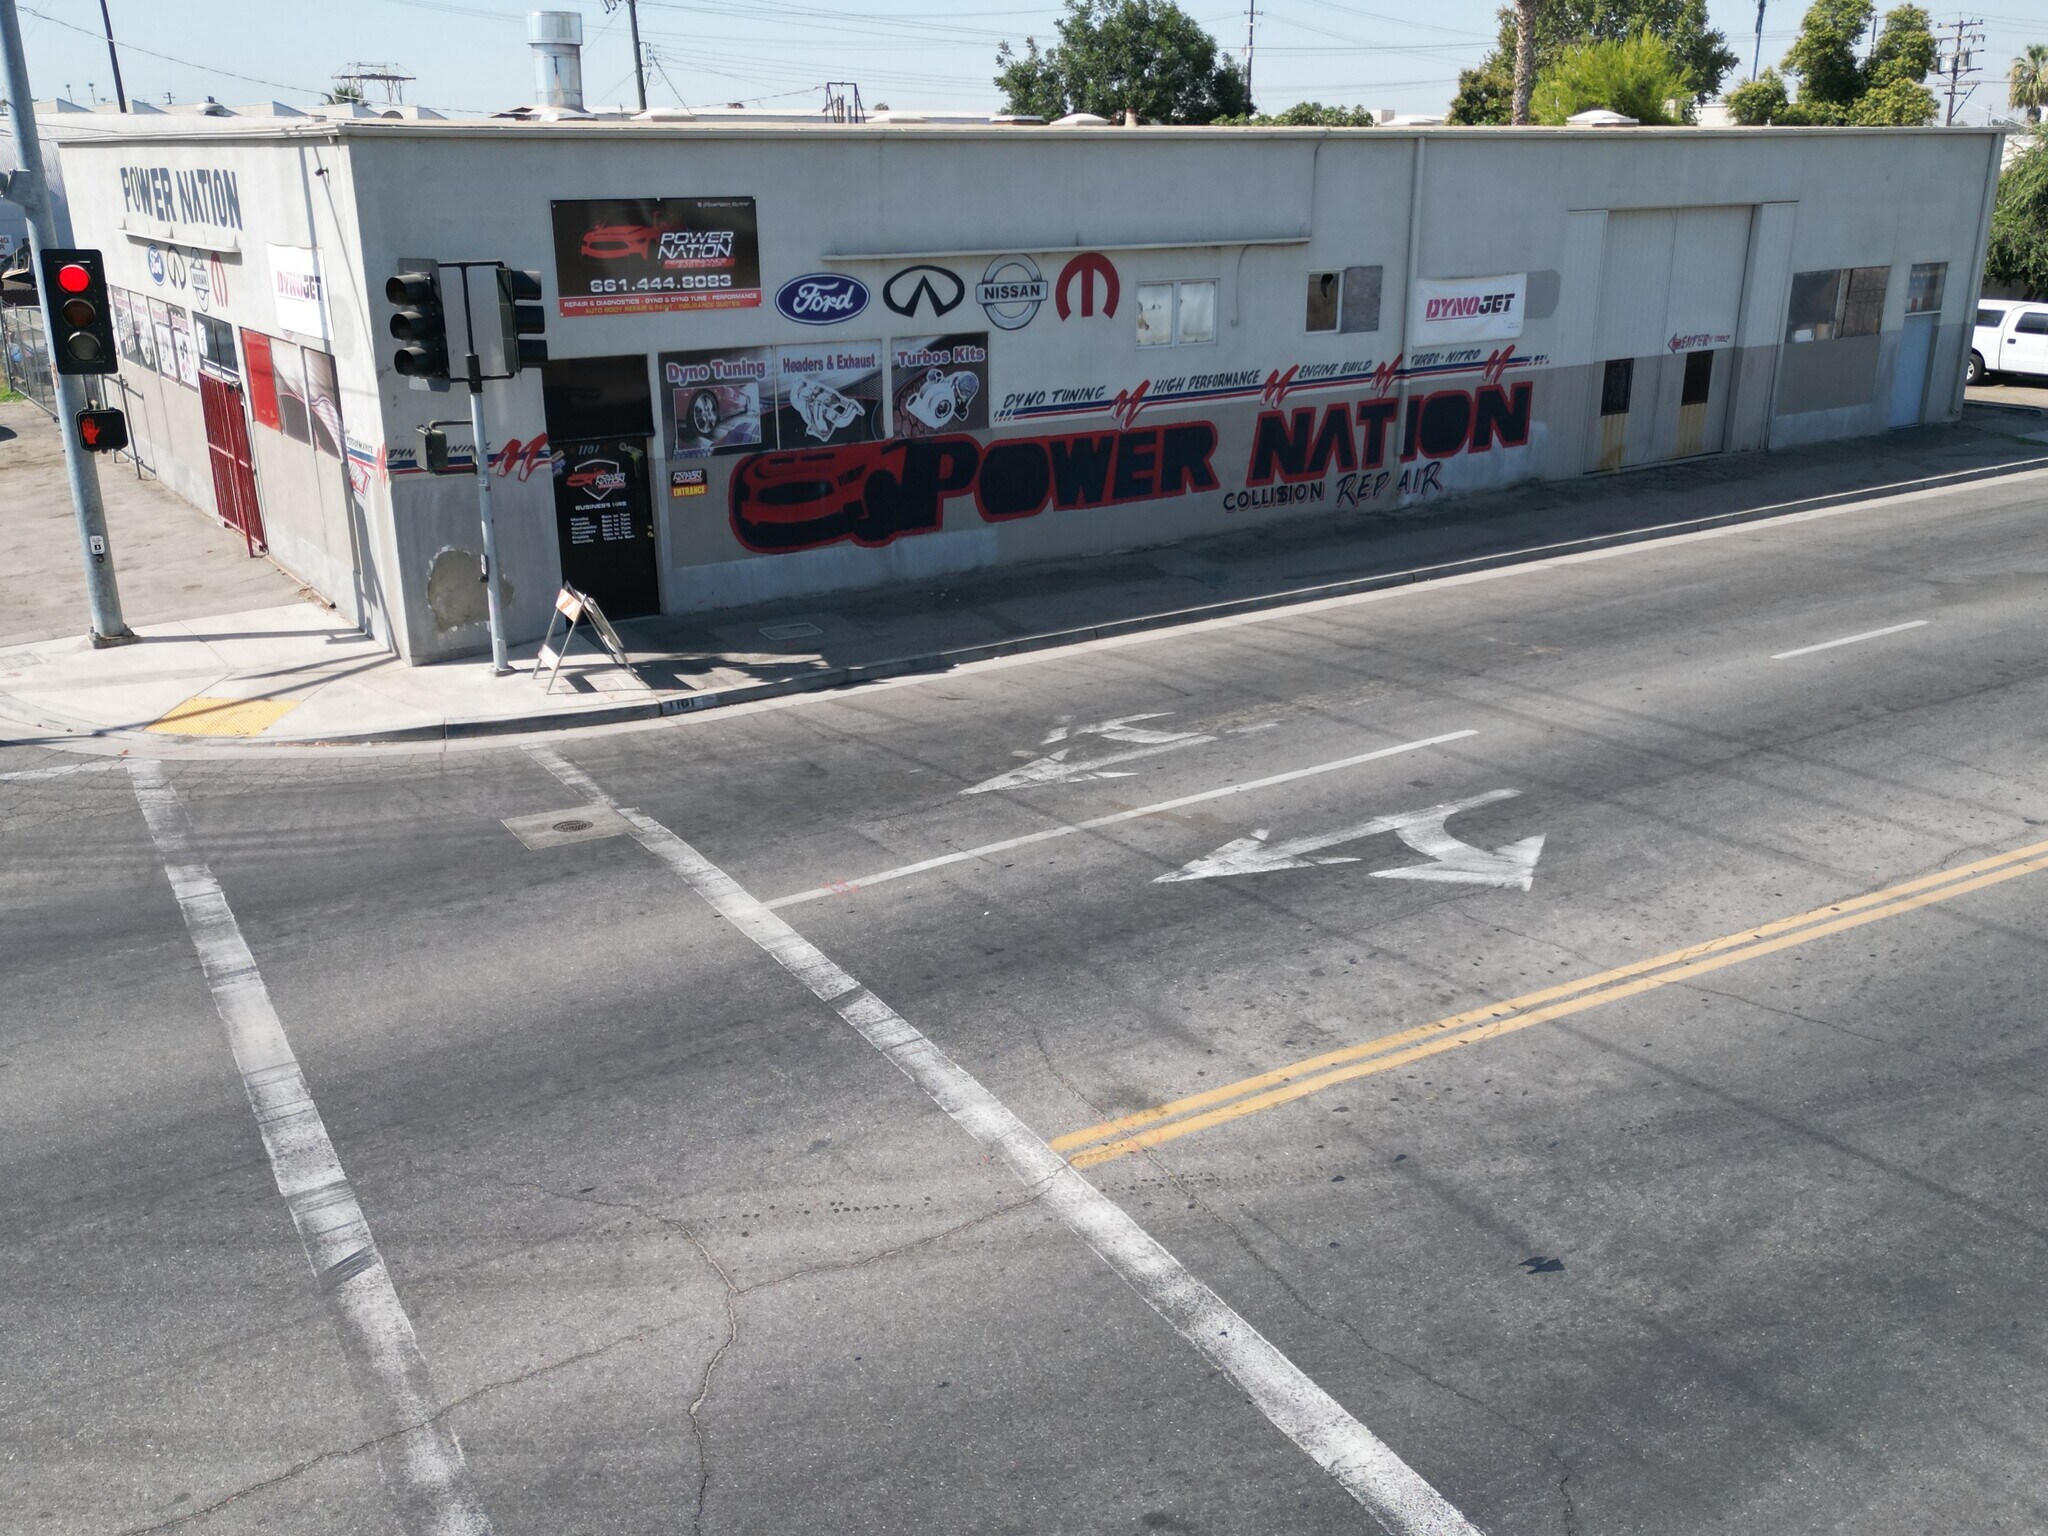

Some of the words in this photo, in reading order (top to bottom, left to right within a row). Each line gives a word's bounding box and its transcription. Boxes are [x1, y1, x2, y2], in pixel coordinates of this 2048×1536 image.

[120, 166, 177, 222] POWER
[175, 168, 243, 231] NATION
[660, 231, 734, 245] POWER
[657, 244, 732, 260] NATION
[277, 270, 321, 302] DYNOJET
[590, 274, 732, 293] 661.444.8083
[984, 284, 1041, 300] NISSAN
[564, 300, 588, 308] REPAIR
[792, 281, 854, 314] Ford
[1425, 293, 1515, 318] DYNOJET
[782, 356, 824, 375] Headers
[826, 356, 835, 370] &
[837, 353, 876, 370] Exhaust
[898, 350, 950, 367] Turbos
[953, 345, 985, 364] Kits
[1411, 352, 1440, 366] TURBO
[1444, 348, 1481, 363] NITRO
[667, 360, 709, 386] Dyno
[711, 357, 766, 380] Tuning
[1298, 363, 1339, 379] ENGINE
[1340, 360, 1373, 374] BUILD
[1152, 377, 1186, 394] HIGH
[1187, 369, 1261, 390] PERFORMANCE
[1003, 390, 1046, 408] DYNO
[1051, 385, 1106, 403] TUNING
[388, 447, 416, 459] DYN
[578, 444, 600, 456] 1101
[897, 420, 1220, 533] POWER
[1245, 381, 1533, 487] NATION
[673, 486, 706, 497] ENTRANCE
[1223, 481, 1325, 513] COLLISION
[1336, 461, 1443, 508] REPAIR
[575, 502, 611, 511] BUSINESS
